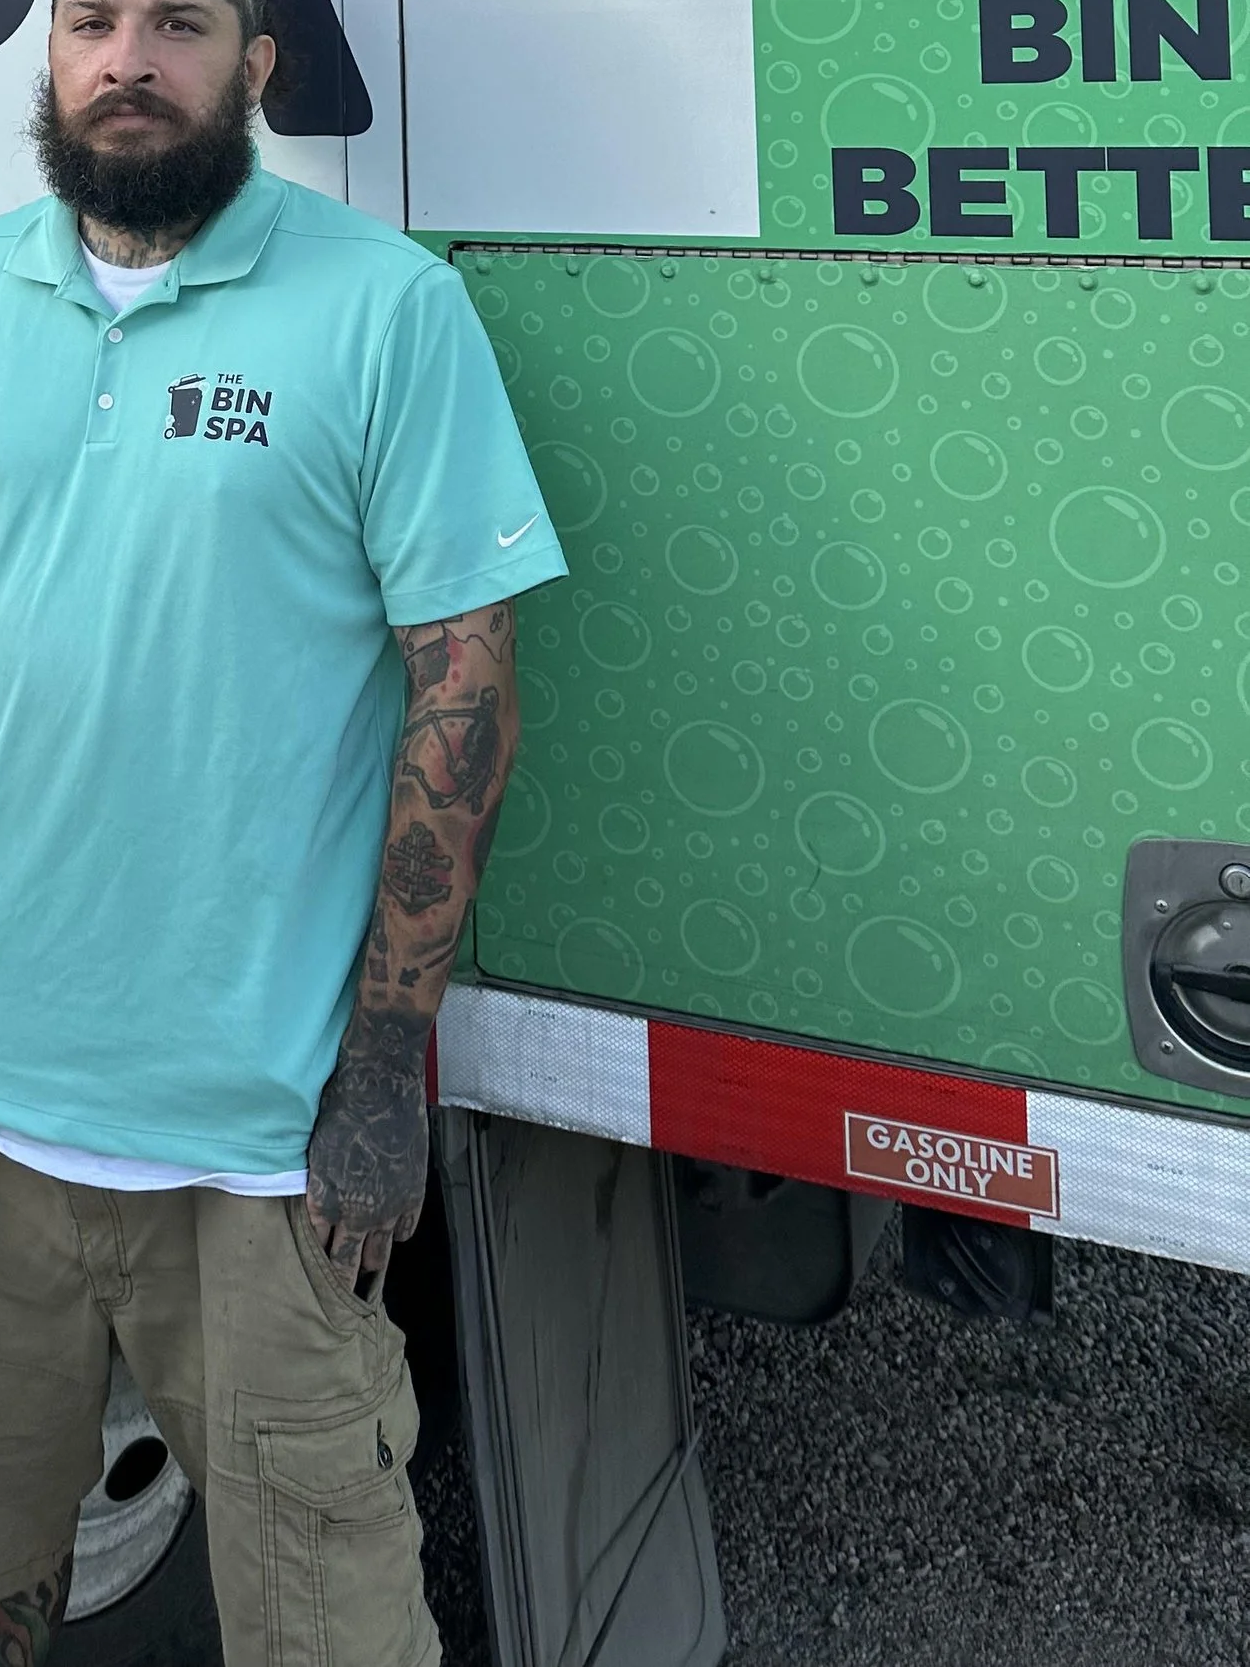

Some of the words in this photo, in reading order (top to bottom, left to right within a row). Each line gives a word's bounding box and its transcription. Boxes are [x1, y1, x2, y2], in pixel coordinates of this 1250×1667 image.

[217, 373, 244, 384] THE
[211, 387, 272, 416] BIN
[203, 416, 269, 447] SPA
[866, 1123, 1033, 1179] GASOLINE
[905, 1158, 992, 1197] ONLY
